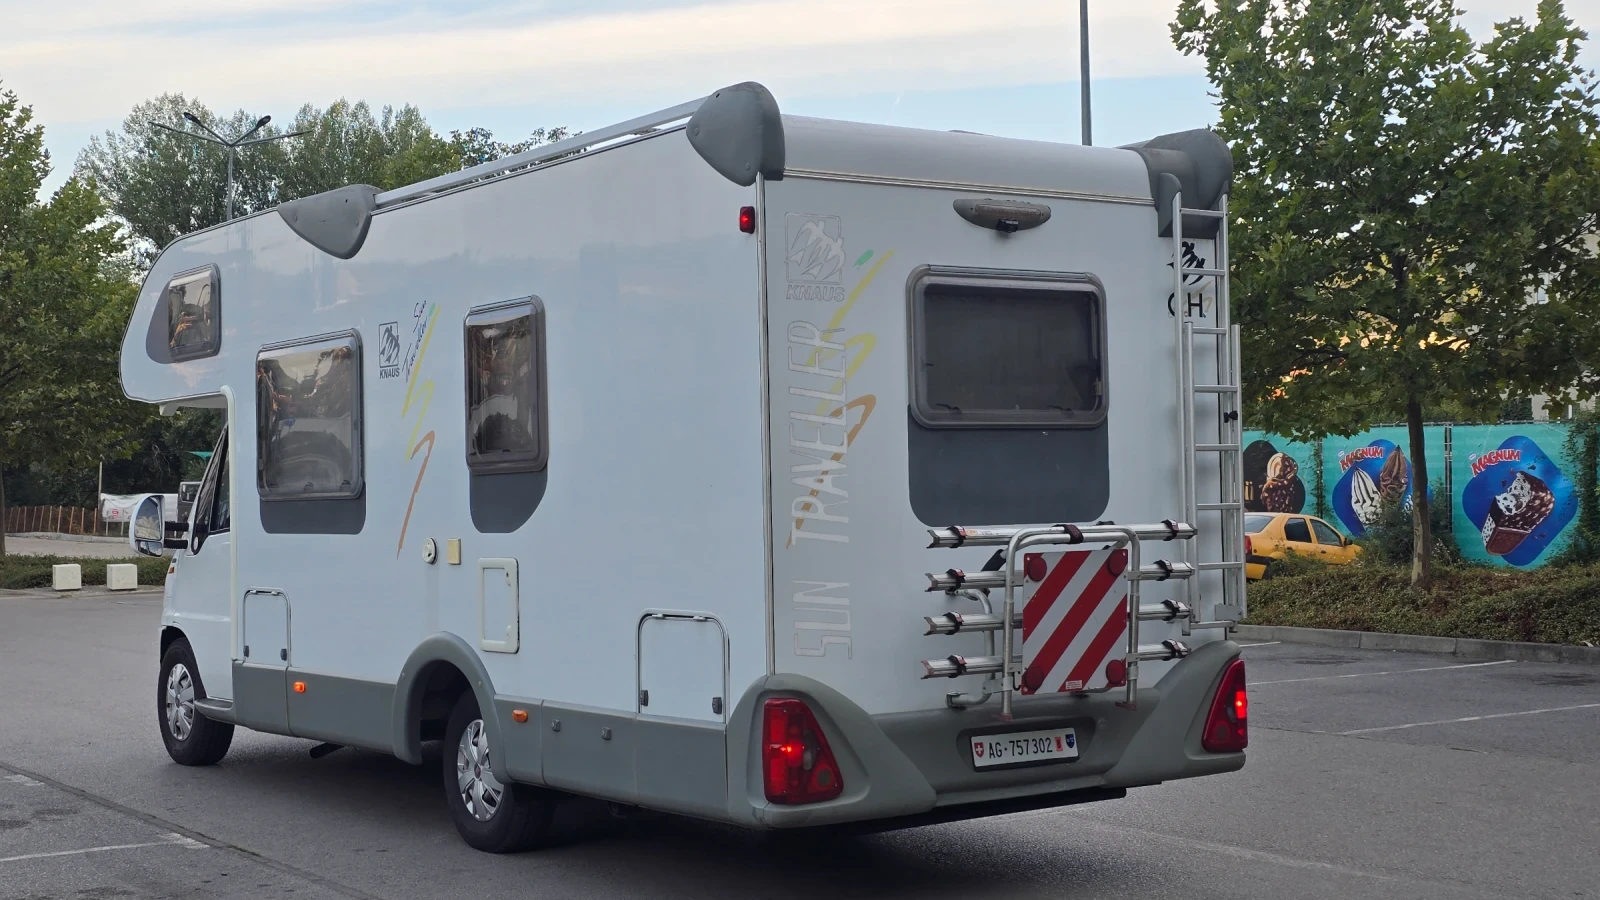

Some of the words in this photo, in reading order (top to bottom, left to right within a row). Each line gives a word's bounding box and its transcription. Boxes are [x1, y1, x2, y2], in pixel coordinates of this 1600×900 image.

[786, 284, 846, 302] KNAUS
[379, 367, 400, 379] KNAUS
[787, 319, 850, 545] TRAVELLER
[1339, 445, 1384, 473] MAGNUM
[1470, 448, 1521, 478] MAGNUM
[792, 579, 852, 660] SUN
